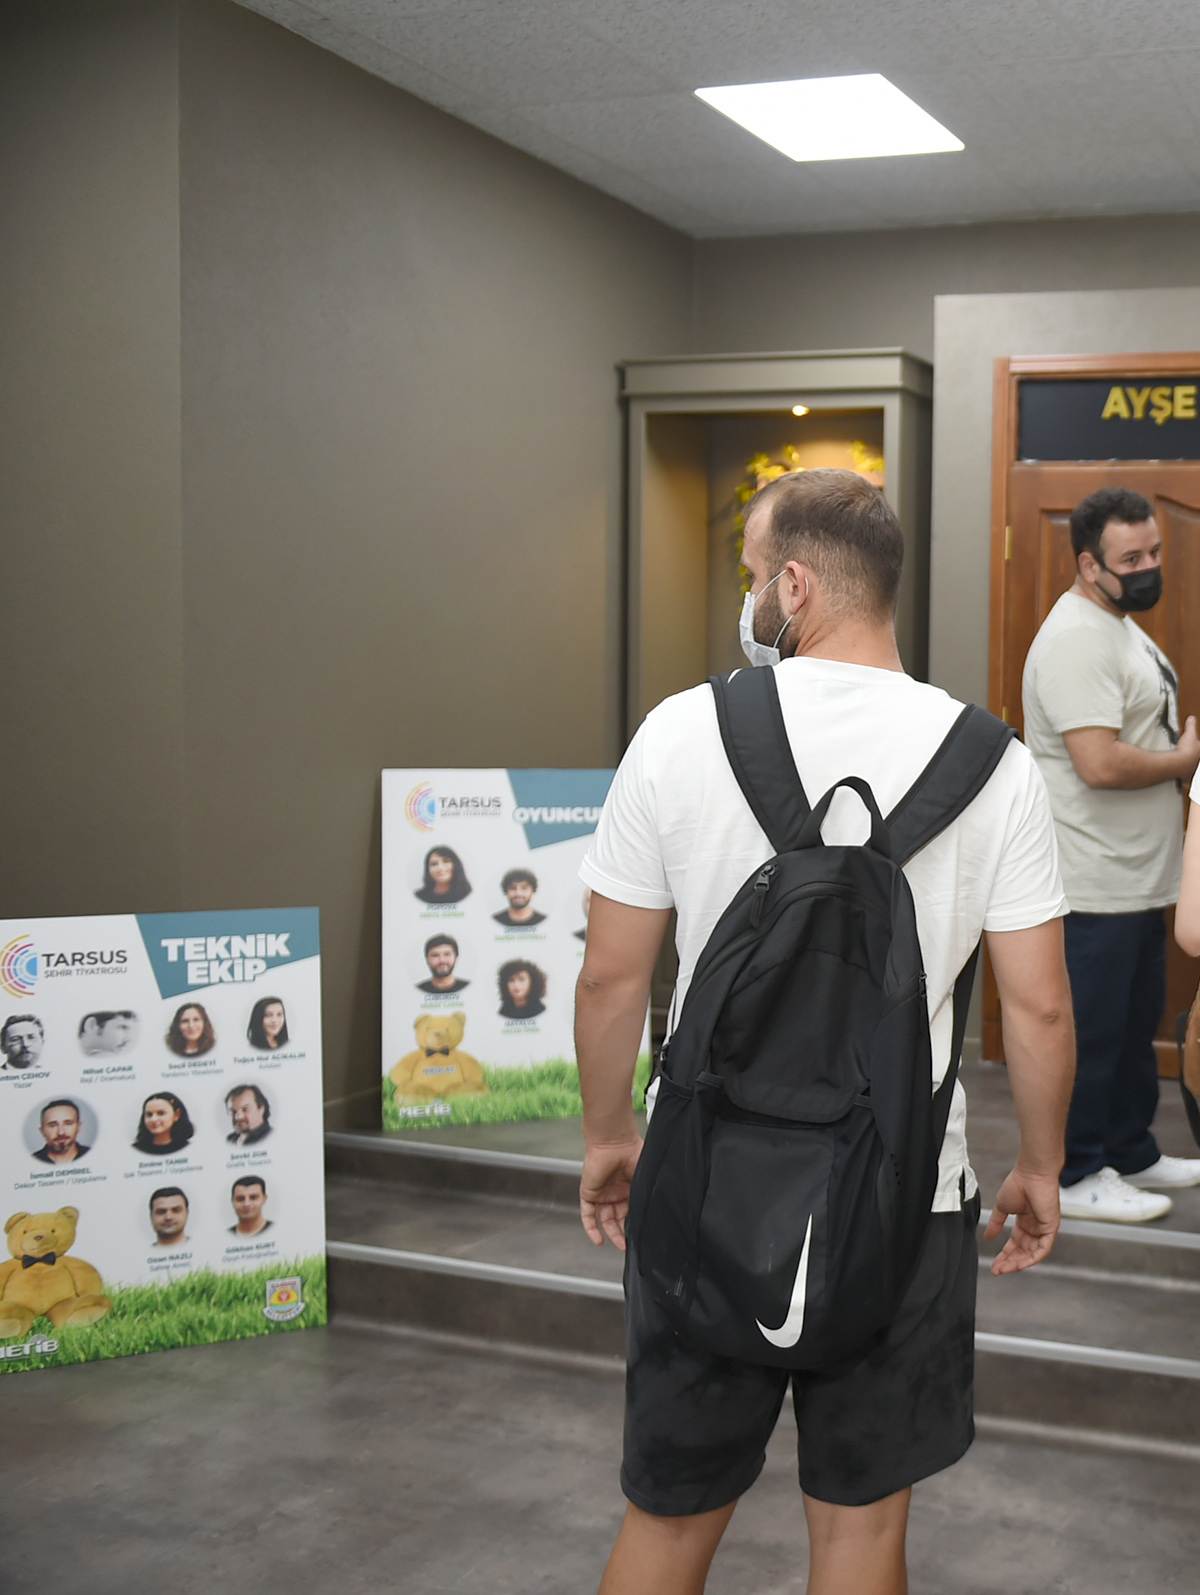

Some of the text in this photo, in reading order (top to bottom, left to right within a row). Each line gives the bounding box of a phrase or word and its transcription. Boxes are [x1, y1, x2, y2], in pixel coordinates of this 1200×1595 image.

[1101, 386, 1197, 424] AYŞE
[438, 795, 502, 808] TARSUS
[161, 932, 291, 963] TEKNİK
[41, 949, 128, 968] TARSUS
[43, 965, 128, 980] ŞEHİR TİYATROSU
[187, 957, 267, 986] EKİP
[0, 1073, 20, 1082] nton
